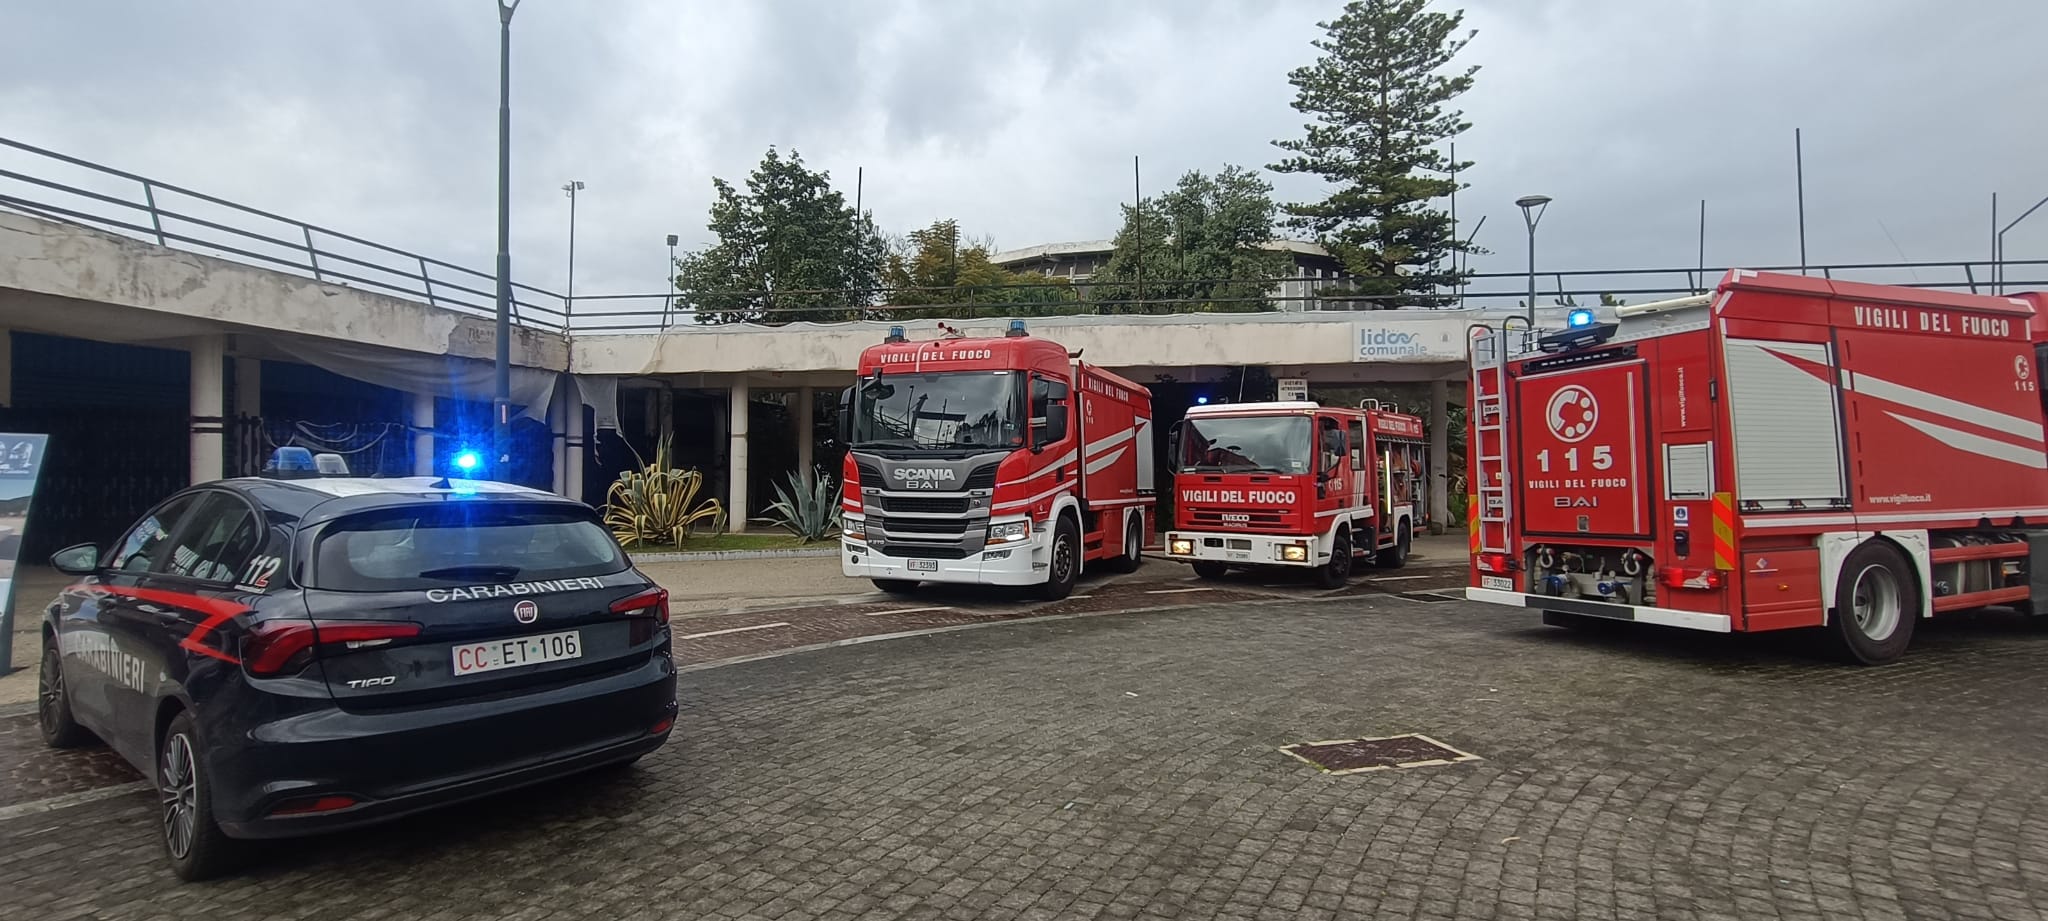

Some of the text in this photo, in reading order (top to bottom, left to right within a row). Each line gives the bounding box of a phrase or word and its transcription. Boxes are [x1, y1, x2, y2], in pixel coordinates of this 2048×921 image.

[1854, 306, 2009, 337] VIGILI DEL FUOCO
[880, 349, 991, 363] VIGILI DEL FUOCO
[1360, 343, 1427, 356] comunale
[1088, 377, 1129, 402] VIGILI DEL FUOCO
[2014, 381, 2035, 391] 115
[1536, 446, 1613, 472] 115
[893, 468, 956, 481] SCANIA
[906, 481, 939, 489] BAI
[1529, 478, 1627, 489] VIGILI DEL FUOCO
[1182, 490, 1296, 504] VIGILI DEL FUOCO
[1554, 496, 1597, 507] BAI
[240, 554, 281, 588] 112
[426, 576, 605, 603] CARABINIERI
[519, 606, 534, 617] FIAT
[458, 634, 577, 671] CC ET 106
[75, 632, 146, 693] CARABINIERI
[346, 675, 397, 689] TIPO
